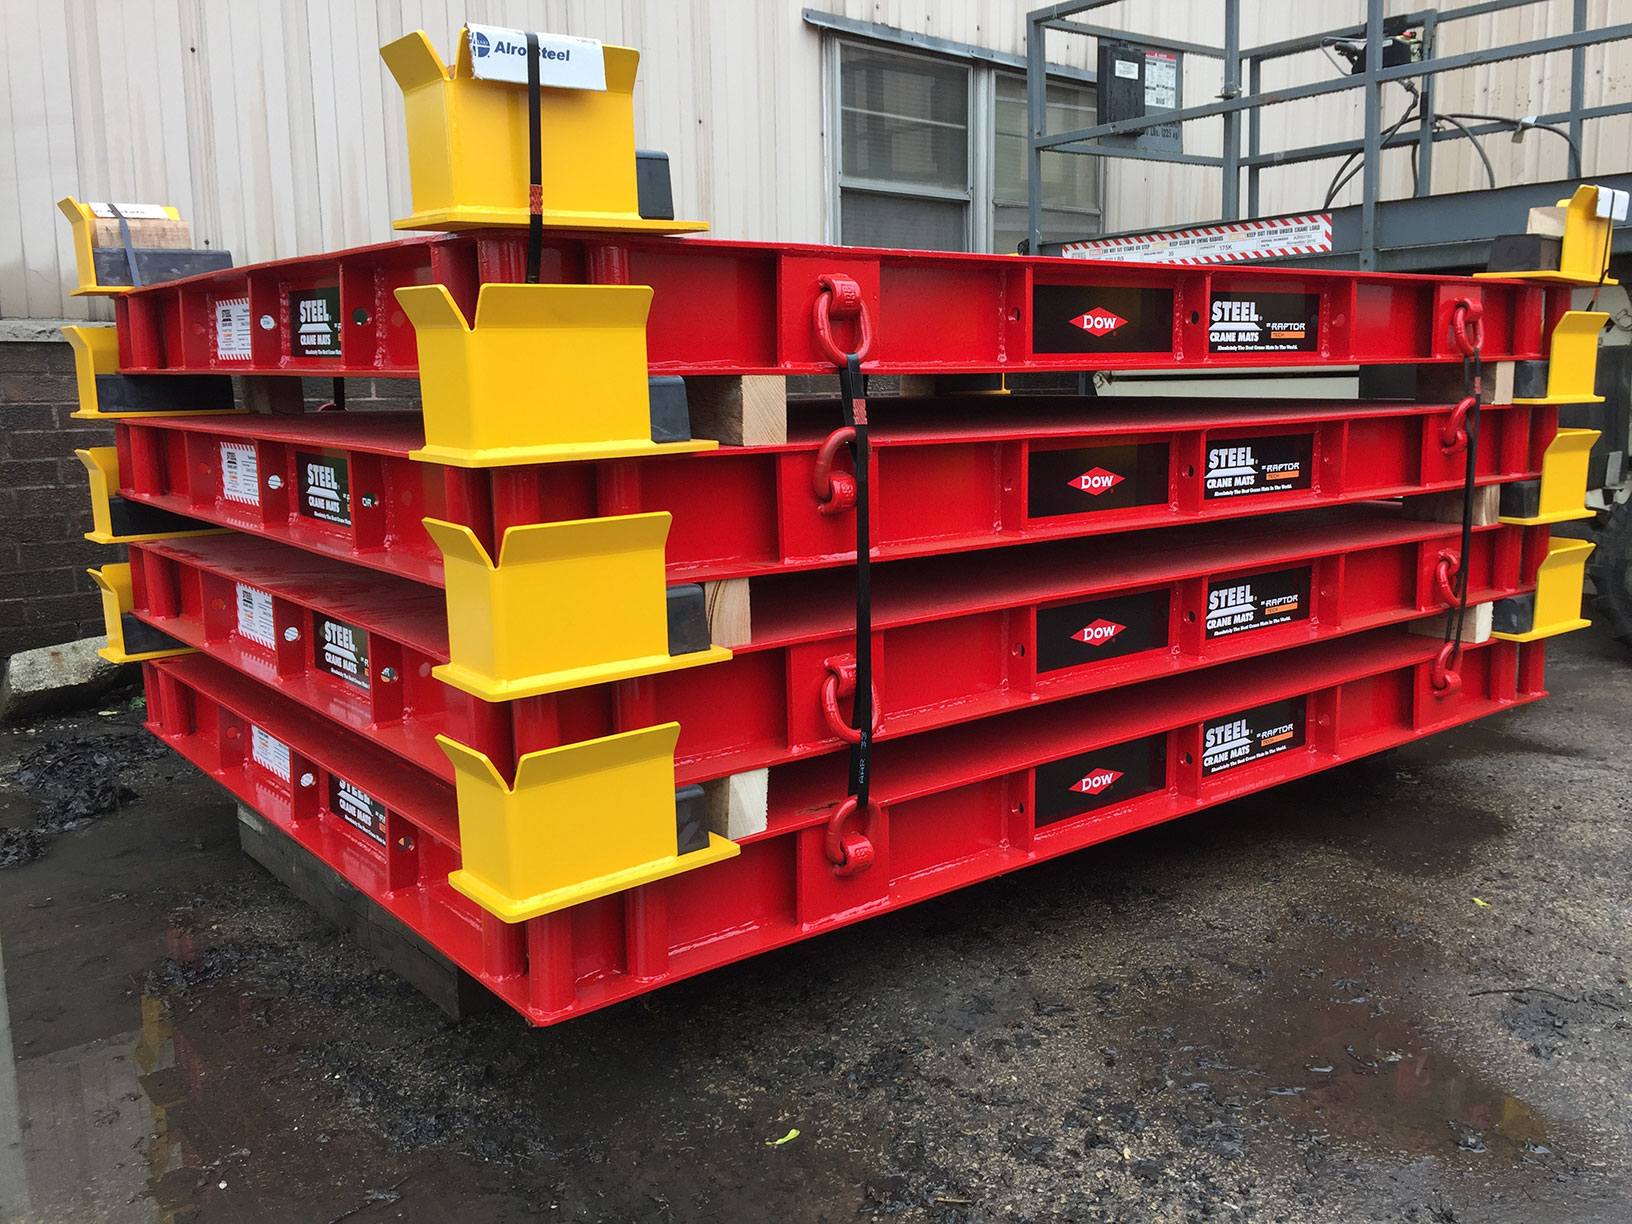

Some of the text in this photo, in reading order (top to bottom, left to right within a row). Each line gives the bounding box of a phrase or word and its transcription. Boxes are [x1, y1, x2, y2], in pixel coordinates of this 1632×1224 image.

[494, 41, 526, 56] Alro
[535, 46, 570, 61] teel
[300, 299, 329, 323] STEEL
[1211, 300, 1259, 322] STEEL
[1209, 332, 1259, 342] CRANE MATS
[1271, 322, 1305, 331] RAPTOR
[300, 334, 331, 346] CRANE MATS
[1208, 446, 1254, 469] STEEL
[1266, 462, 1300, 472] RAPTOR
[307, 463, 338, 490] STEEL
[1206, 475, 1255, 489] CRANE MATS
[308, 496, 340, 513] CRANE MATS
[1208, 584, 1254, 610] STEEL
[1265, 594, 1298, 607] RAPTOR
[1206, 612, 1254, 630] CRANE MATS
[324, 620, 355, 653] STEEL
[324, 652, 342, 668] CRANE
[342, 659, 358, 674] MATS
[1205, 719, 1249, 748] STEEL
[1261, 723, 1294, 739] RAPTOR
[1203, 745, 1250, 767] CRANE MATS
[339, 798, 356, 818] CRANE
[356, 808, 372, 827] MATS
